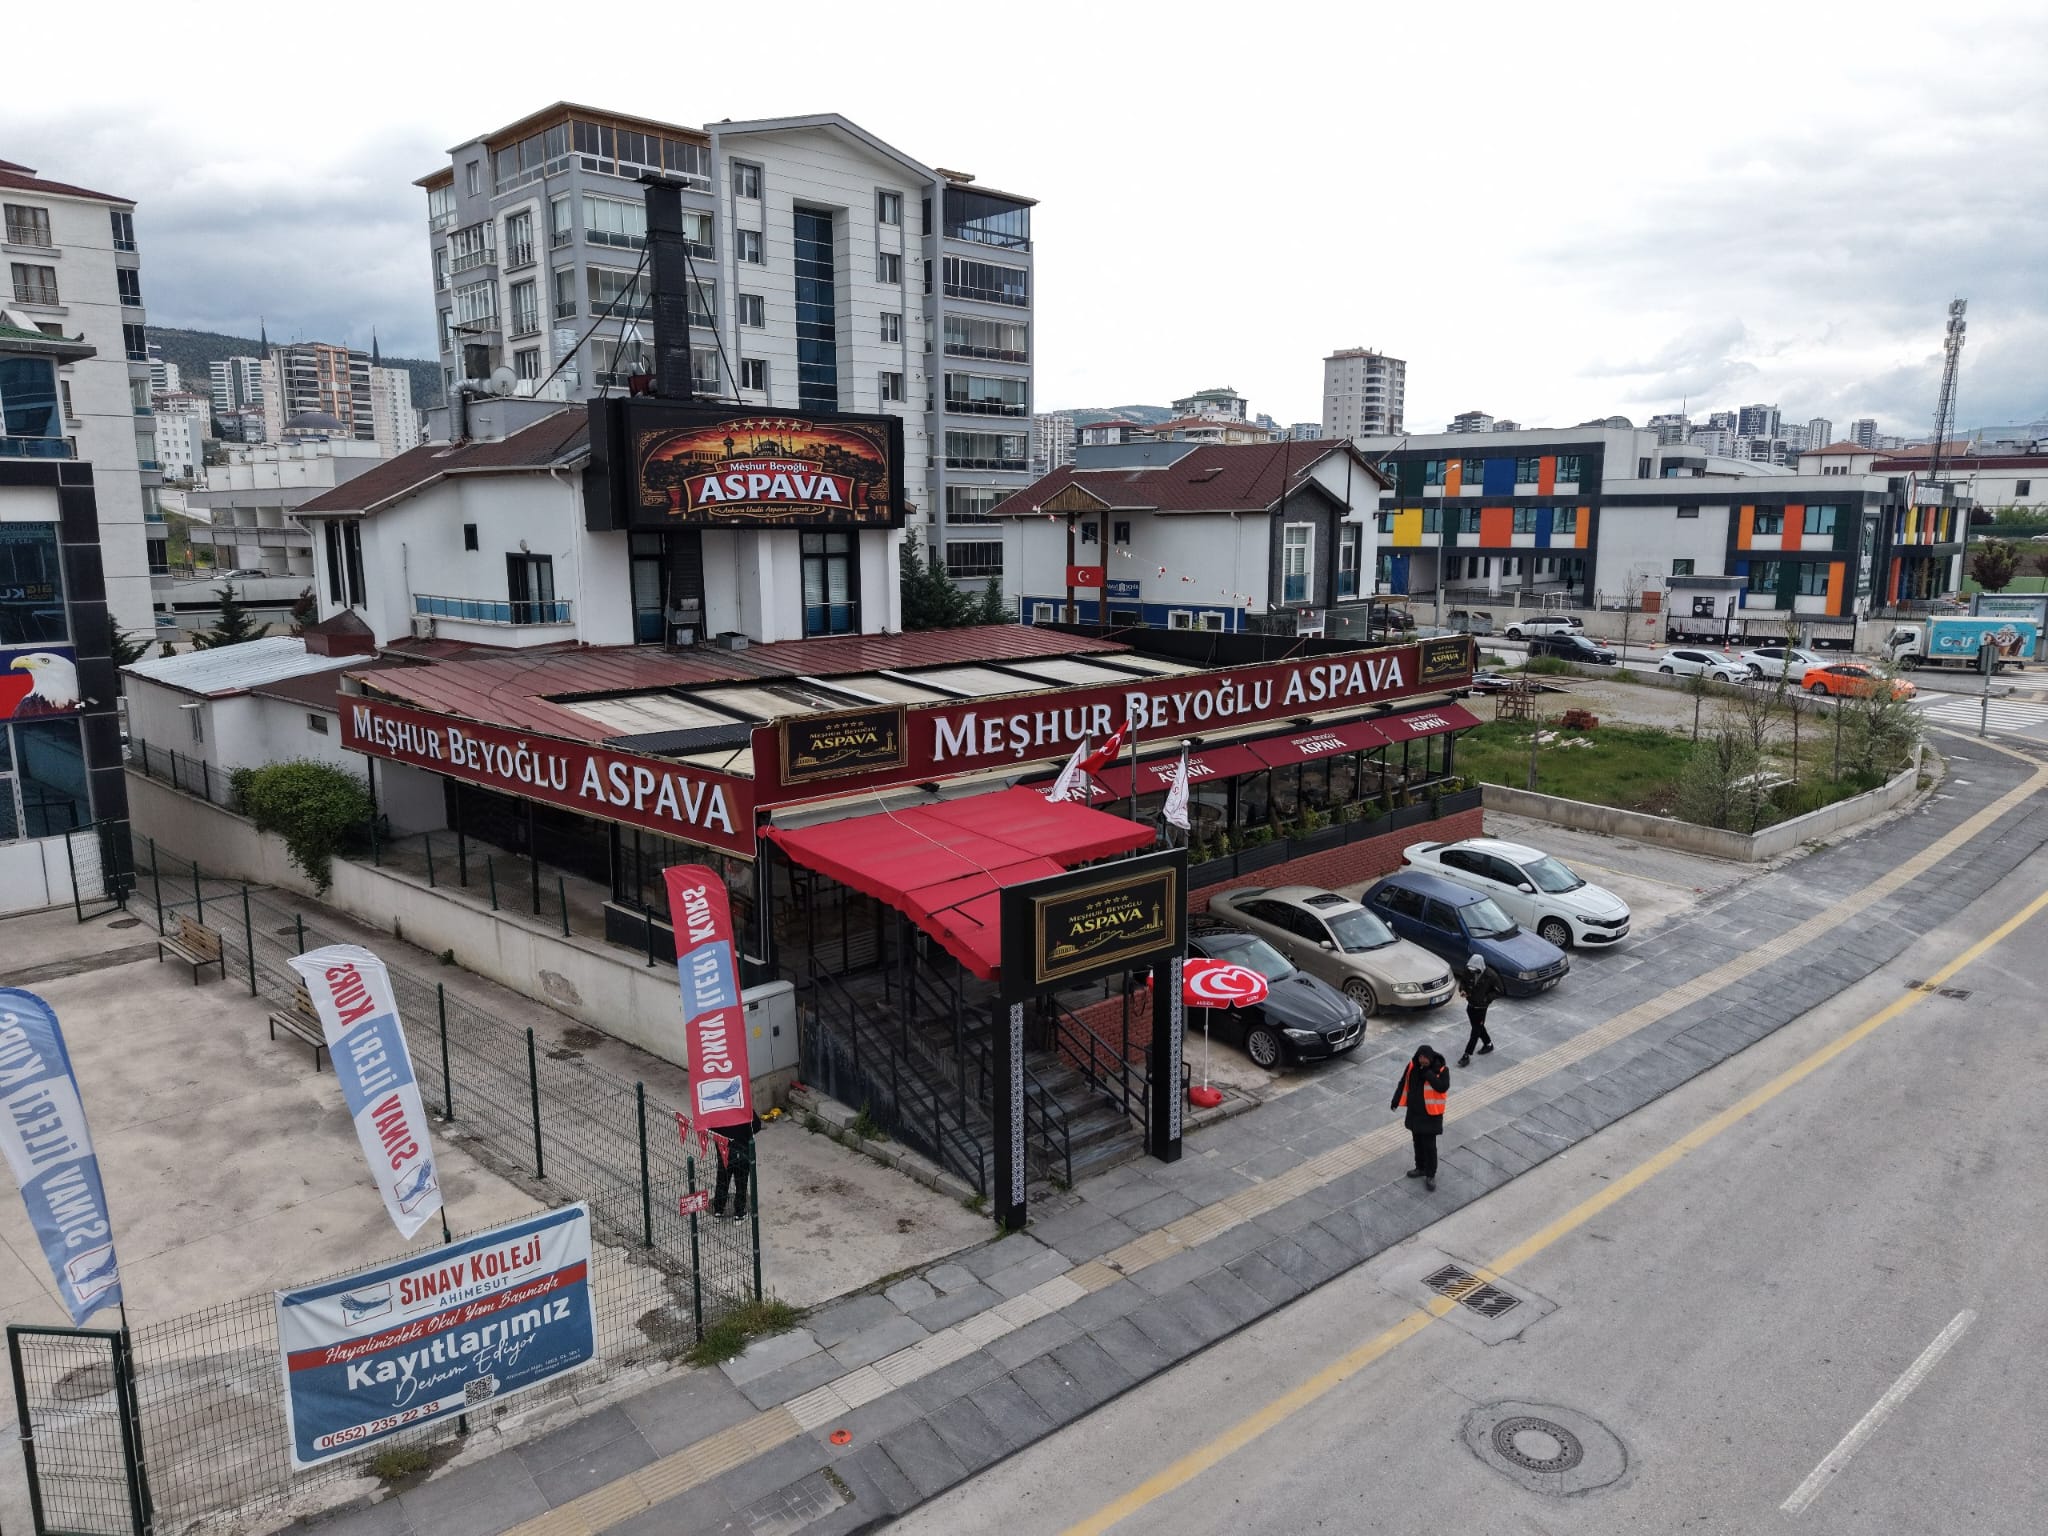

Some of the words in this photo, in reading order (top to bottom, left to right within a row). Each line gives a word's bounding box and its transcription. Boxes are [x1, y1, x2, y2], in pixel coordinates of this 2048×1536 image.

[770, 462, 808, 473] Beyoğlu
[698, 474, 842, 503] ASPAVA
[1432, 653, 1459, 663] ASPAVA
[932, 703, 1112, 761] MEŞHUR
[1125, 677, 1273, 732] BEYOĞLU
[1283, 656, 1404, 706] ASPAVA
[1409, 717, 1450, 732] ASPAVA
[811, 732, 878, 750] ASPAVA
[1299, 739, 1346, 755] ASPAVA
[353, 705, 442, 755] MEŞHUR
[447, 727, 567, 791] BEYOĞLU
[579, 756, 735, 835] ASPAVA
[1158, 764, 1216, 783] ASAVA
[1069, 908, 1144, 936] ASPAVA
[400, 1263, 465, 1305] SINAV
[470, 1235, 541, 1282] KOLEJİ
[439, 1276, 509, 1307] AHİMESUT
[326, 1323, 423, 1364] Hayalinizdeki
[427, 1315, 458, 1334] Okul
[347, 1297, 570, 1390] Kayıtlarımız
[392, 1364, 468, 1408] Devam
[473, 1332, 537, 1374] Ediyor
[321, 1424, 367, 1449] 0(552)
[371, 1417, 398, 1434] 235
[402, 1409, 418, 1424] 22
[423, 1401, 440, 1416] 33
